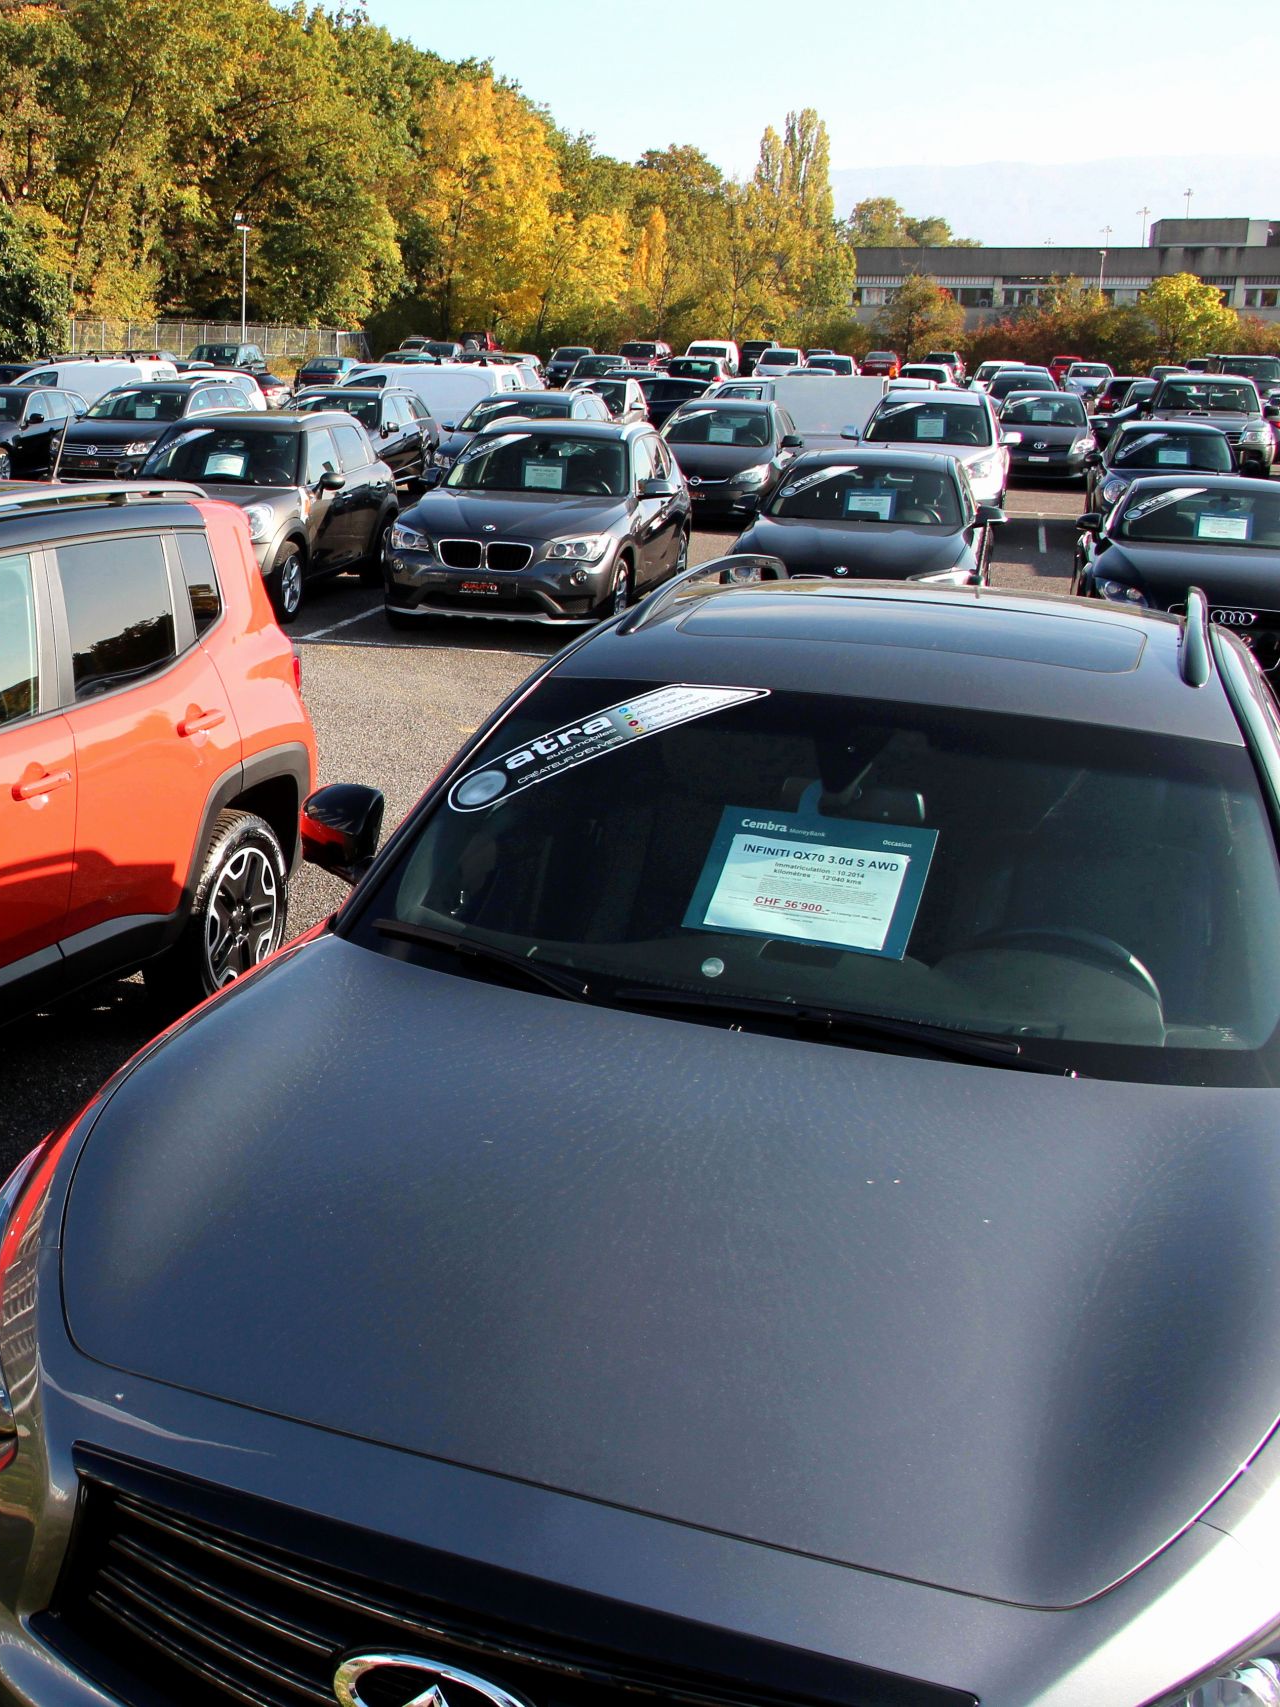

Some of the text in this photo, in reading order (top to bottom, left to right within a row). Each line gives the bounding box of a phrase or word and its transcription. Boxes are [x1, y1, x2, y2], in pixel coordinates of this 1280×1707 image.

[1138, 496, 1166, 510] atra
[630, 690, 677, 711] Garantie
[636, 693, 694, 718] Assurance
[639, 695, 710, 724] Financement
[646, 706, 706, 730] Assistance
[505, 714, 613, 771] atra
[545, 728, 617, 761] automobiles
[516, 753, 575, 785] CRÉATEUR
[741, 818, 788, 833] Cembra
[882, 839, 913, 849] Occasion
[743, 843, 899, 872] INFINITI QX70 3.0d S AWD
[775, 861, 831, 874] Immatriculation
[846, 878, 862, 886] kms
[754, 895, 782, 906] CHF
